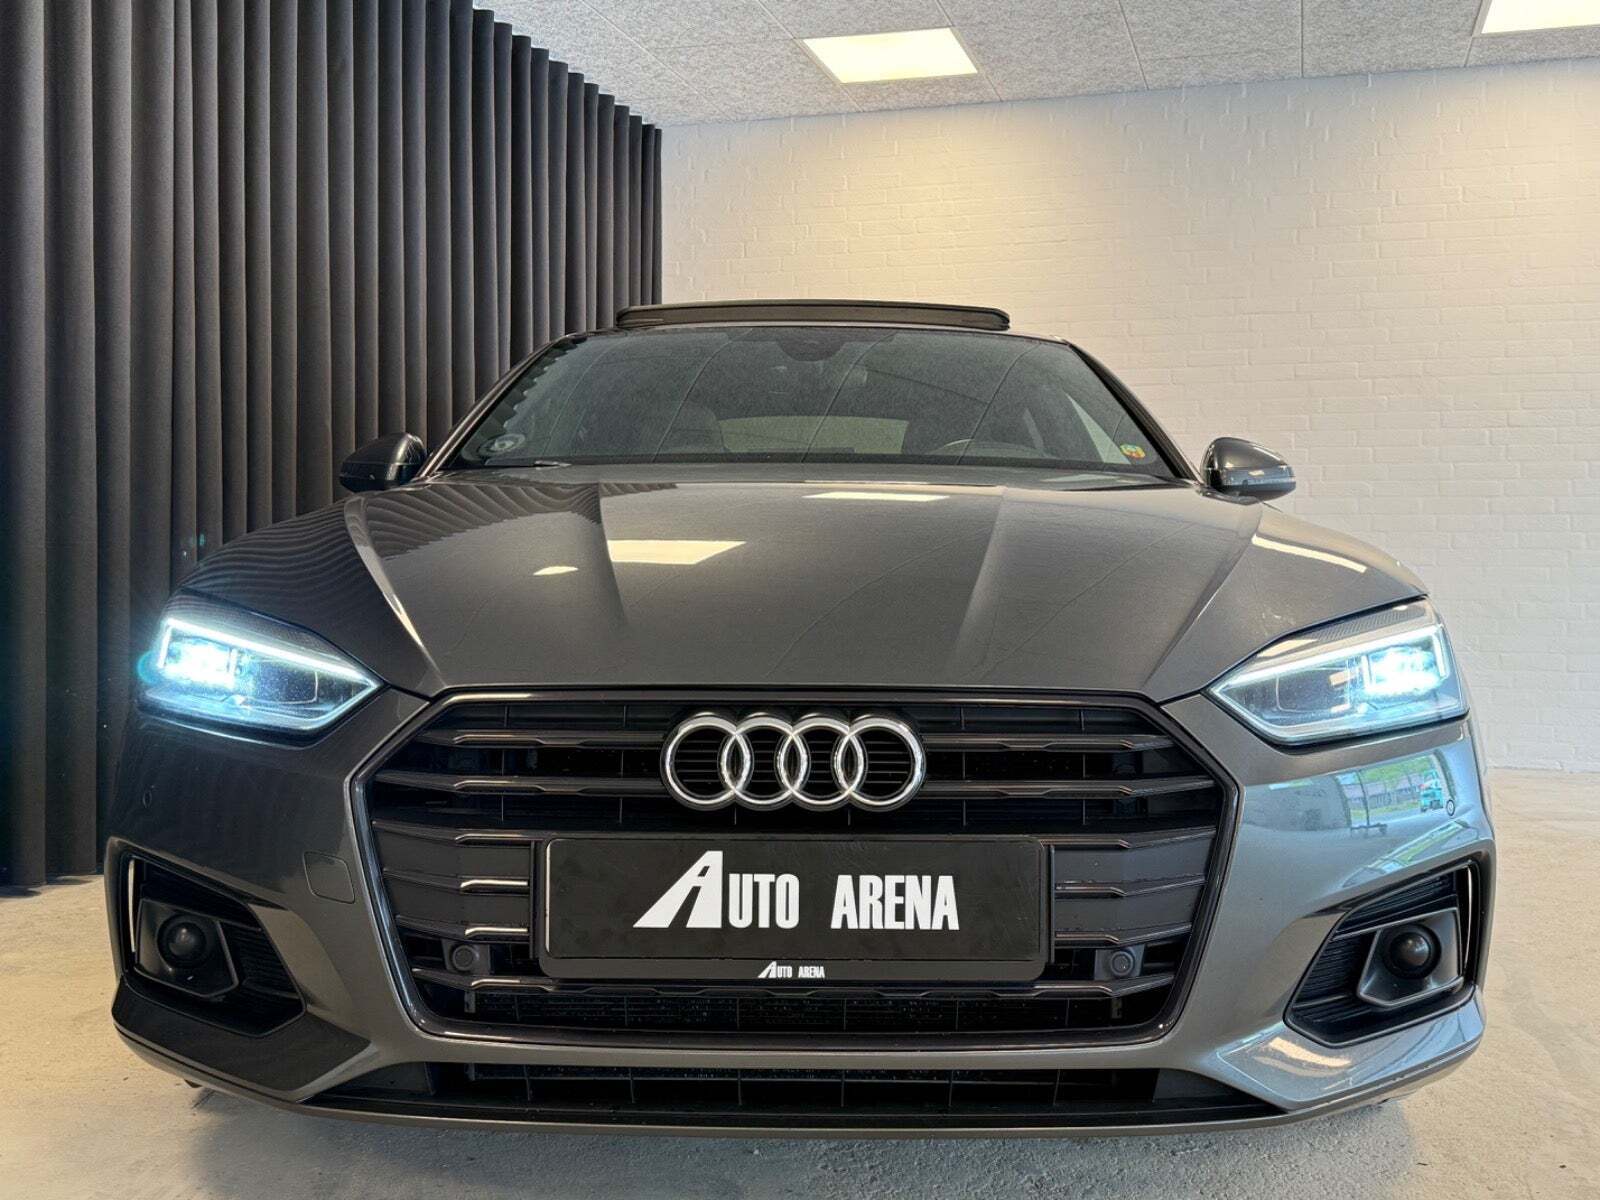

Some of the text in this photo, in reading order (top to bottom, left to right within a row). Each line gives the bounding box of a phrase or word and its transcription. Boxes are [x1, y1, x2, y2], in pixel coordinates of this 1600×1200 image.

[633, 850, 960, 931] AUTO ARENA
[757, 961, 825, 979] AUTO ARENA
